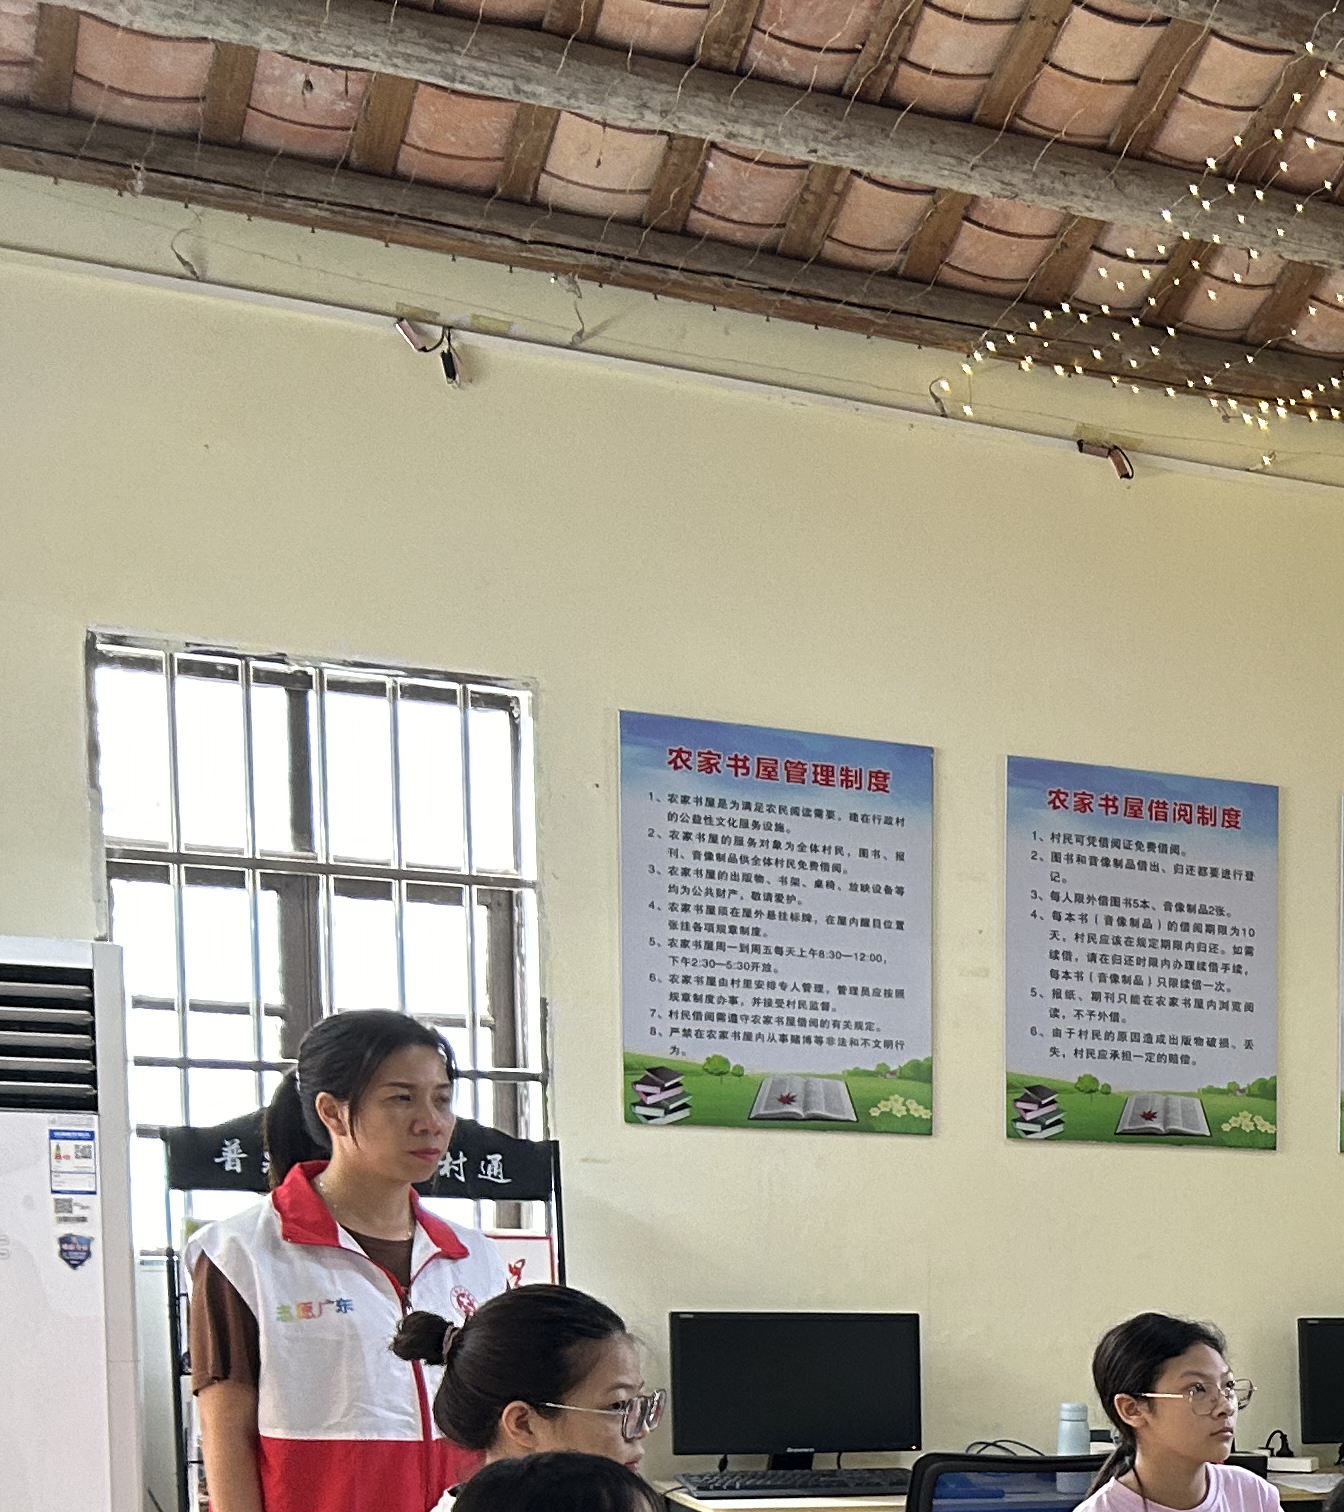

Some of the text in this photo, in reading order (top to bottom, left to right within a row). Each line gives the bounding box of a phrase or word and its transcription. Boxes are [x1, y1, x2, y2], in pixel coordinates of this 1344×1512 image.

[668, 745, 890, 793] 农家书屋管理制度
[1047, 789, 1241, 830] 农家书屋借阅制度
[1050, 871, 1067, 884] 记。
